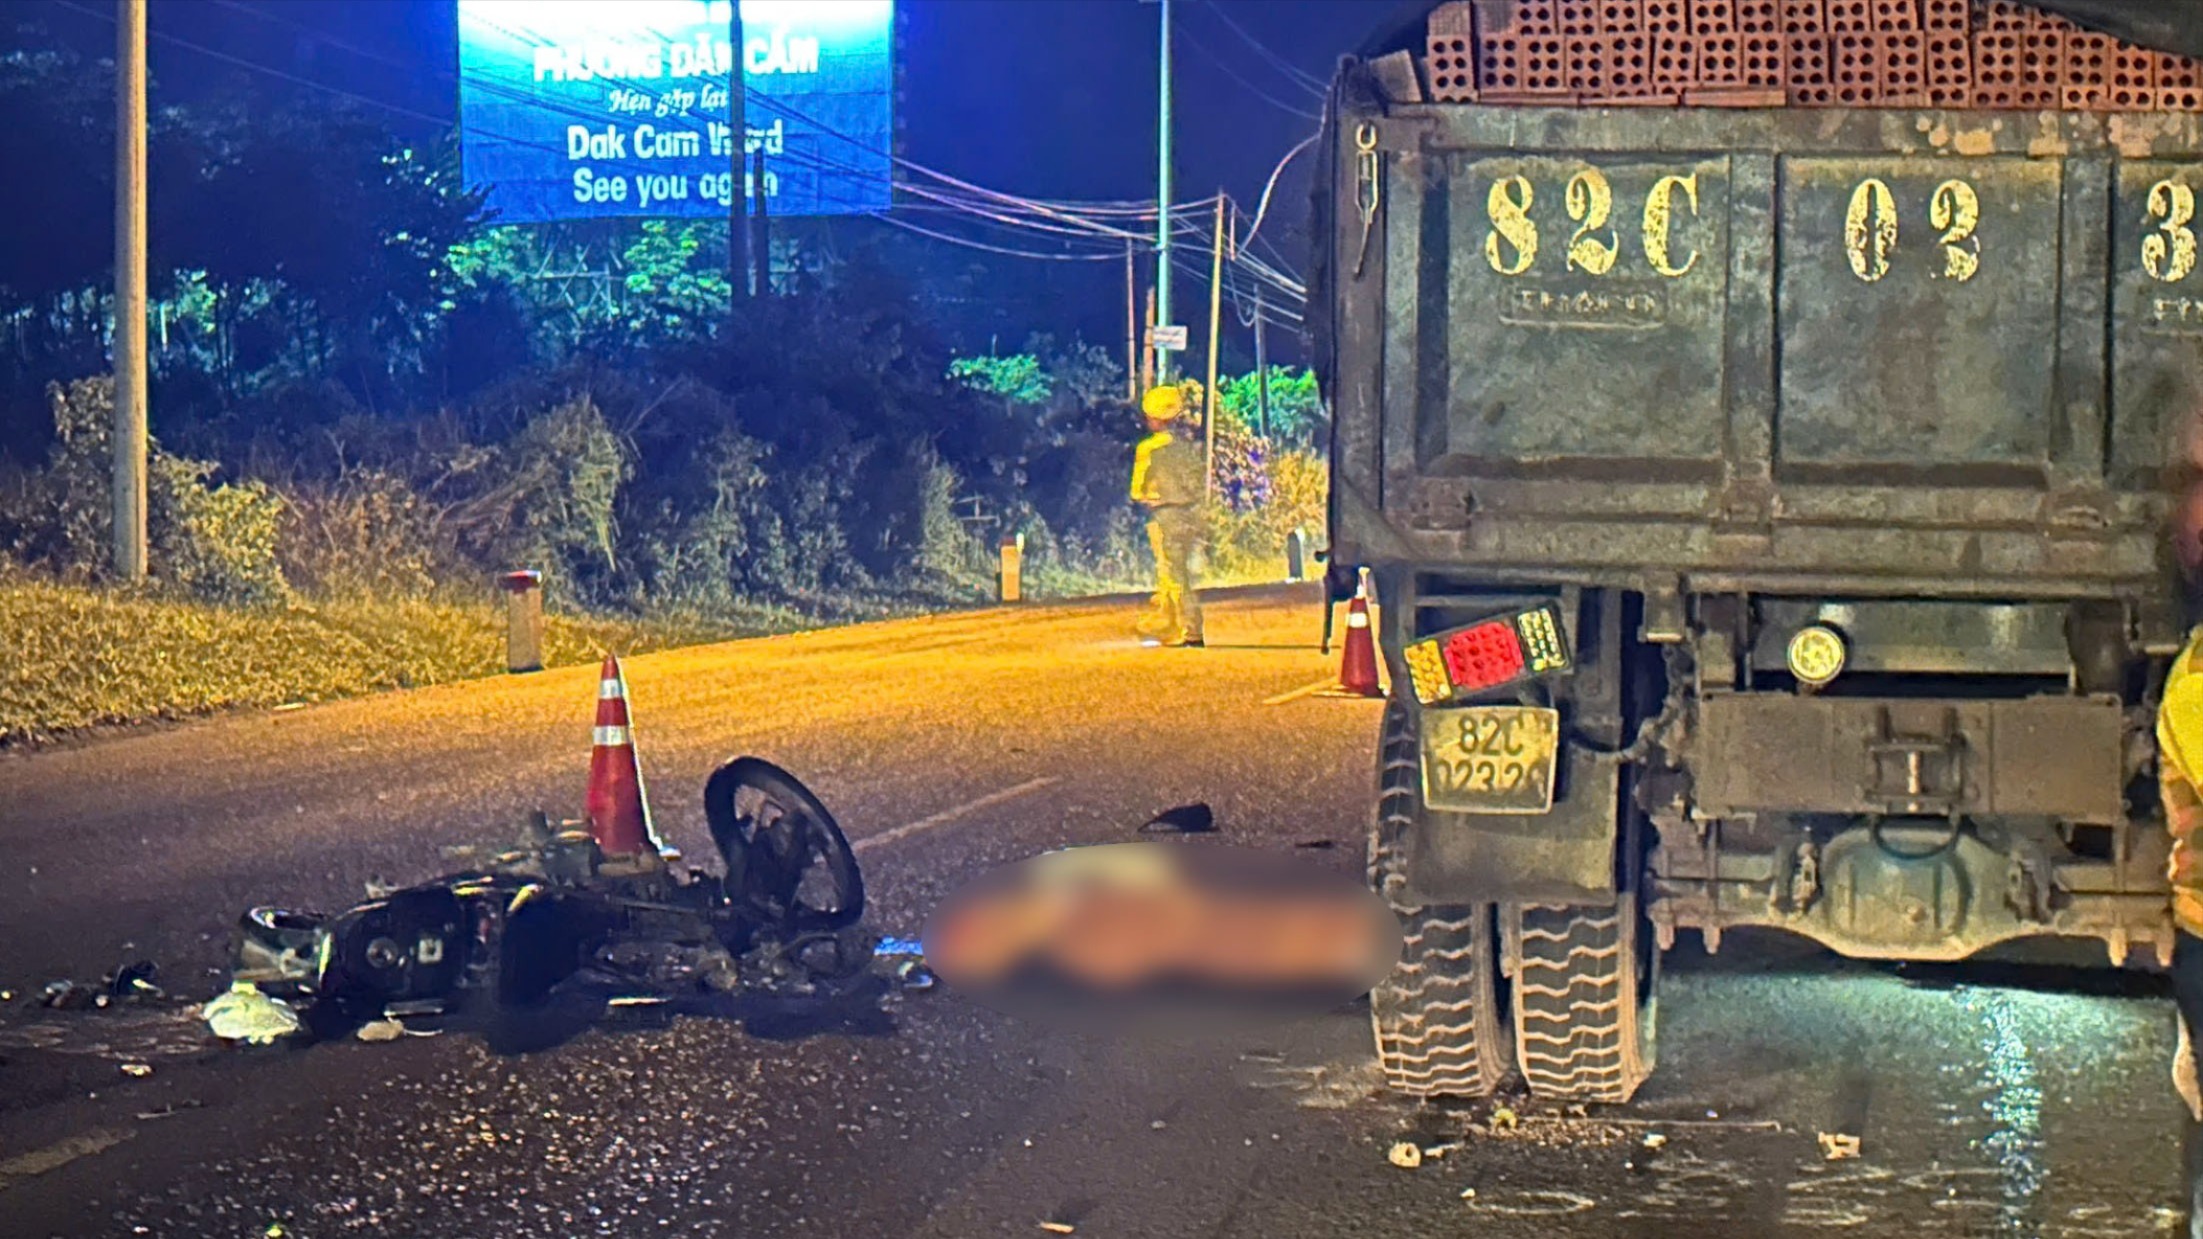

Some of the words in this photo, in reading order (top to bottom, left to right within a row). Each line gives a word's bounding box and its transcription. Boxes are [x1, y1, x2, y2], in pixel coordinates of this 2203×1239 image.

[567, 124, 627, 161] Dak
[634, 123, 701, 159] Cam
[573, 166, 628, 204] See
[635, 174, 689, 209] you
[700, 170, 779, 207] agn
[1485, 170, 1699, 276] 82C
[1458, 714, 1524, 757] 82C
